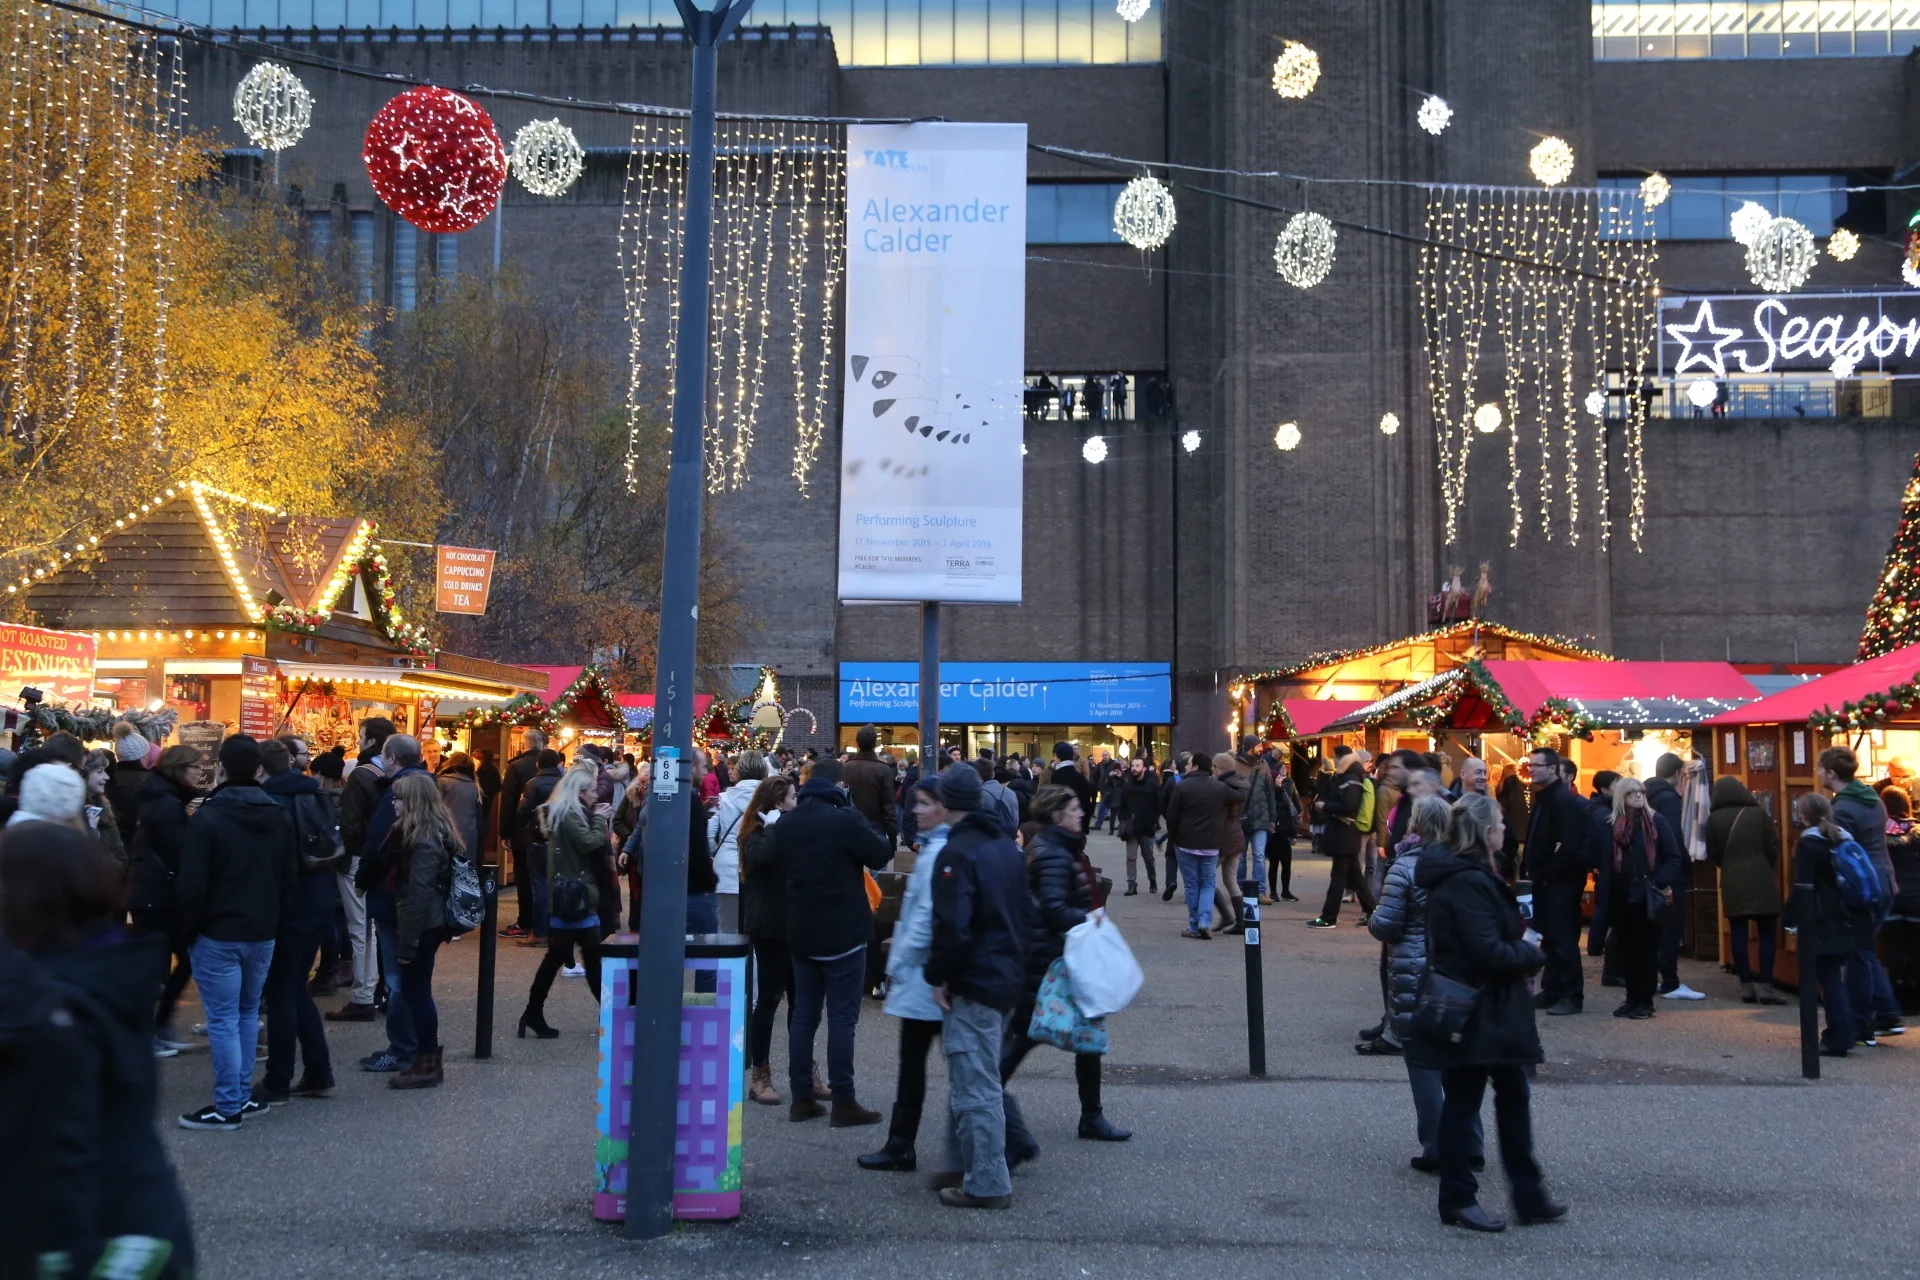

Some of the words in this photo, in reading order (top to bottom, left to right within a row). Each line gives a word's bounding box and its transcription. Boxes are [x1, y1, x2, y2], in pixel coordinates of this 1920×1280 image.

[864, 149, 909, 168] TATE
[863, 198, 1010, 223] Alexander
[863, 228, 952, 252] Calder
[856, 514, 919, 528] Performing
[923, 515, 977, 528] Sculpture
[855, 538, 863, 546] 11
[866, 538, 910, 547] November
[912, 539, 932, 547] 2015
[950, 540, 969, 549] April
[972, 540, 992, 548] 2016
[446, 552, 456, 560] HOT
[457, 553, 486, 562] CHOCOLATE
[444, 566, 485, 577] CAPPUCCINO
[443, 581, 459, 589] COLD
[461, 582, 483, 592] DRINKS
[453, 594, 470, 606] TEA
[0, 629, 17, 643] OT
[19, 631, 68, 650] ROASTED
[251, 661, 268, 673] Menu
[849, 678, 961, 698] Alexaner
[969, 677, 1039, 698] Calder
[849, 699, 892, 709] Performing
[893, 699, 919, 708] Sculptu
